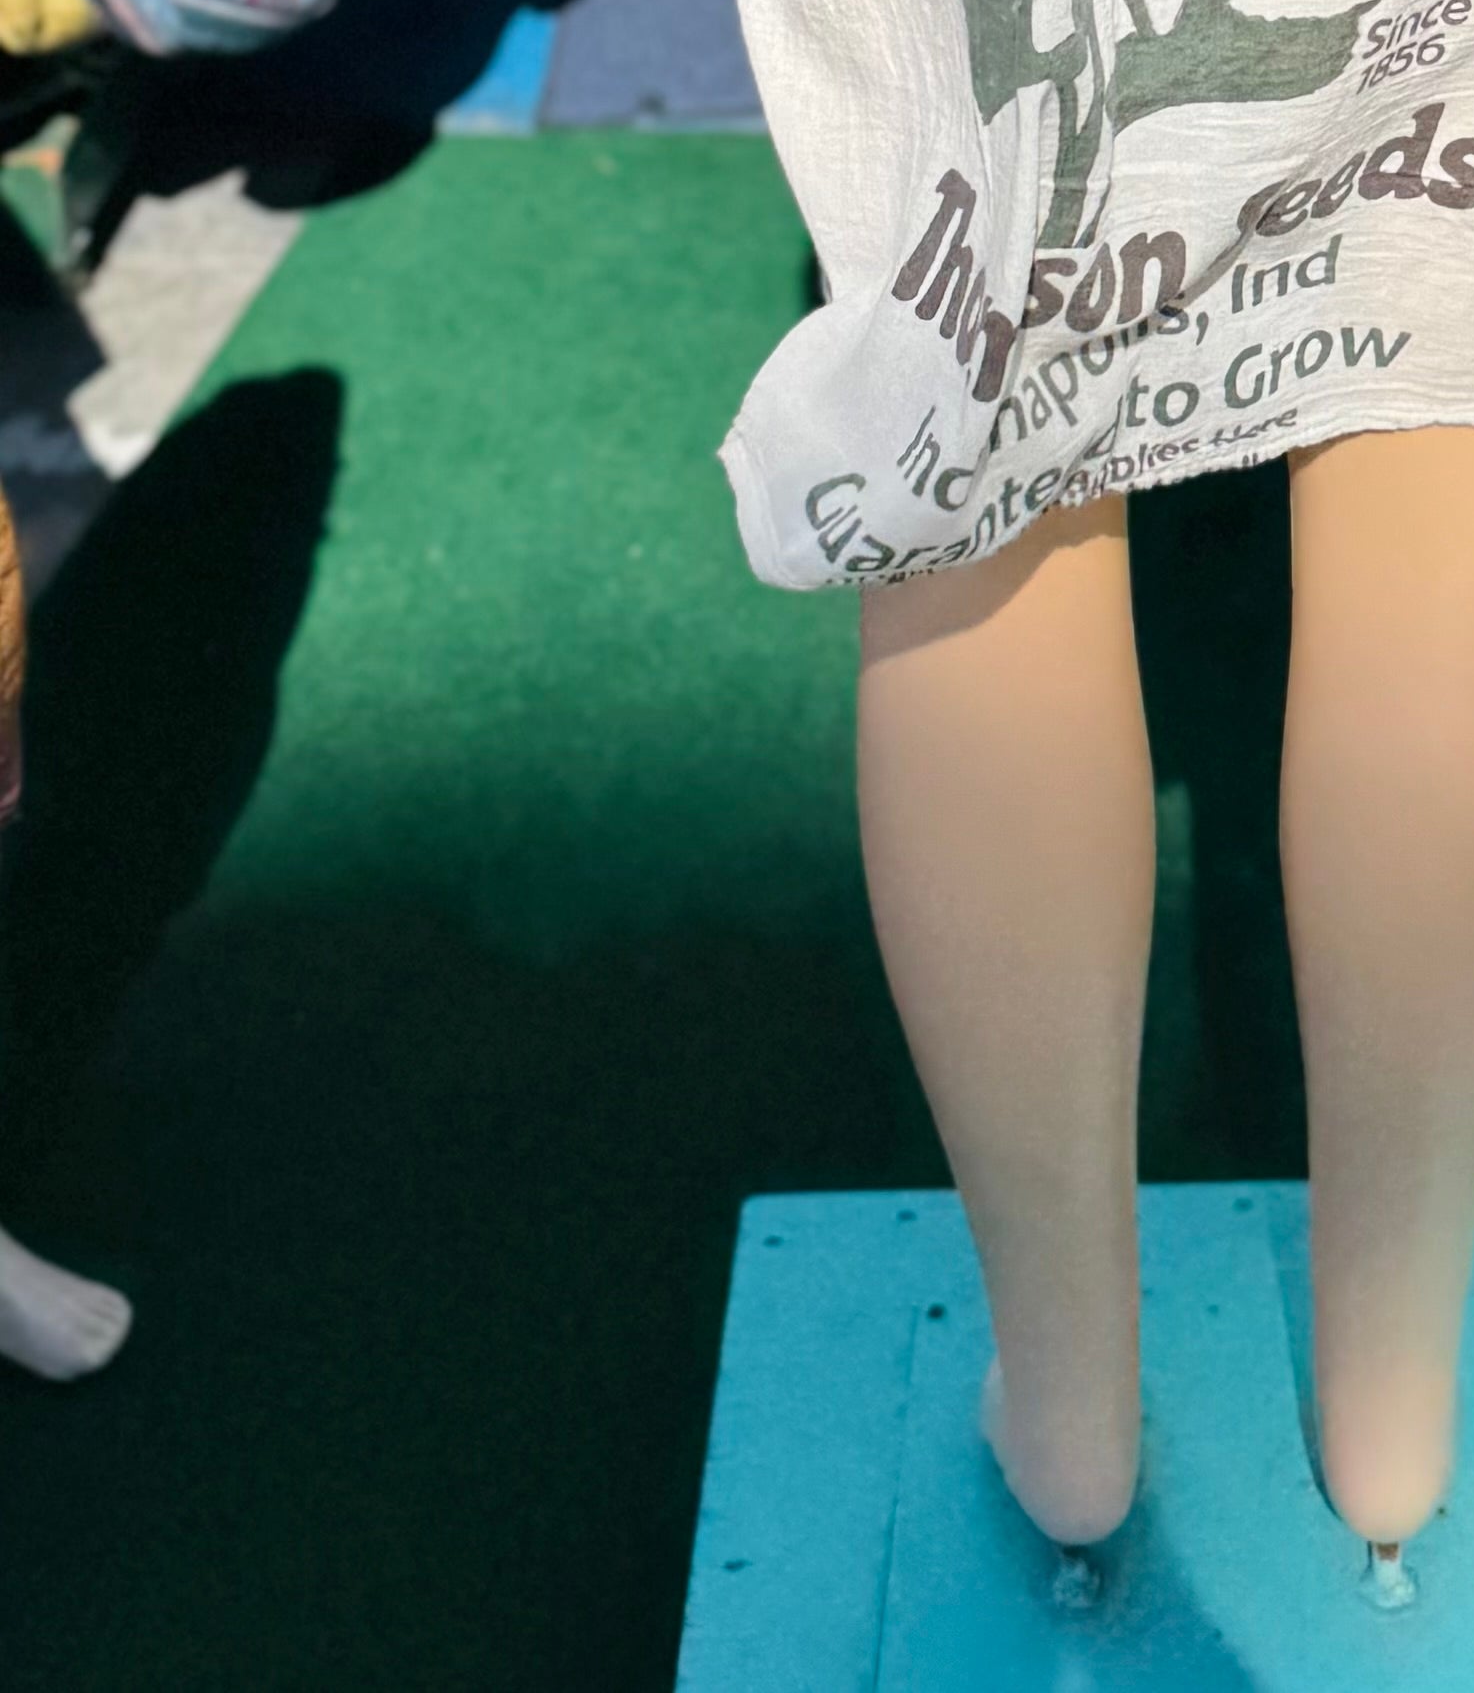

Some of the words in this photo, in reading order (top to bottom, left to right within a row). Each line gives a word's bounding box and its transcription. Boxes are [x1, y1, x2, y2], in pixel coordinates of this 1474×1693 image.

[1356, 33, 1446, 95] 1856
[1230, 233, 1342, 314] Ind
[1125, 375, 1200, 428] to
[1224, 326, 1411, 409] Grow
